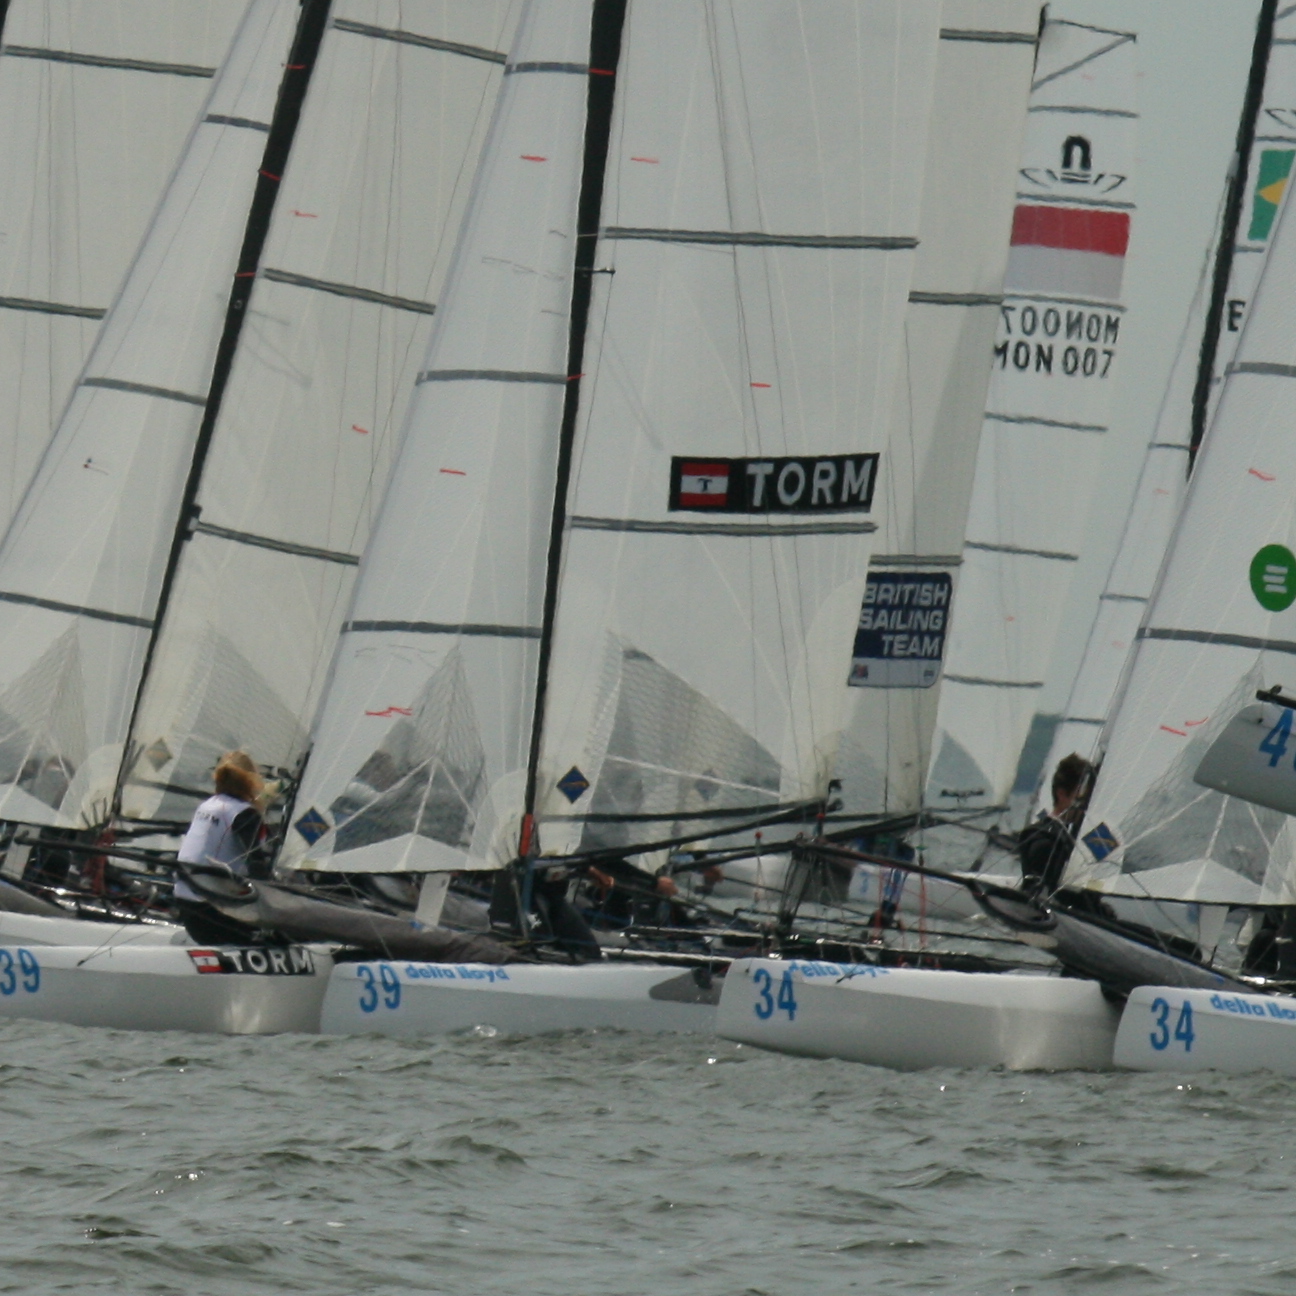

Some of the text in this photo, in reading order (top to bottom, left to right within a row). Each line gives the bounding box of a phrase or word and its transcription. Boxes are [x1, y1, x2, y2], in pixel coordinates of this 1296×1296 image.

[746, 458, 873, 507] TORM
[858, 606, 945, 631] SAILING
[863, 582, 949, 606] BRITISH
[881, 633, 942, 657] TEAM
[1259, 708, 1296, 771] 4
[222, 947, 314, 975] TORM
[356, 964, 511, 1014] 39 delta lloyd
[753, 967, 798, 1021] 34
[1150, 993, 1296, 1052] 34 delta llo
